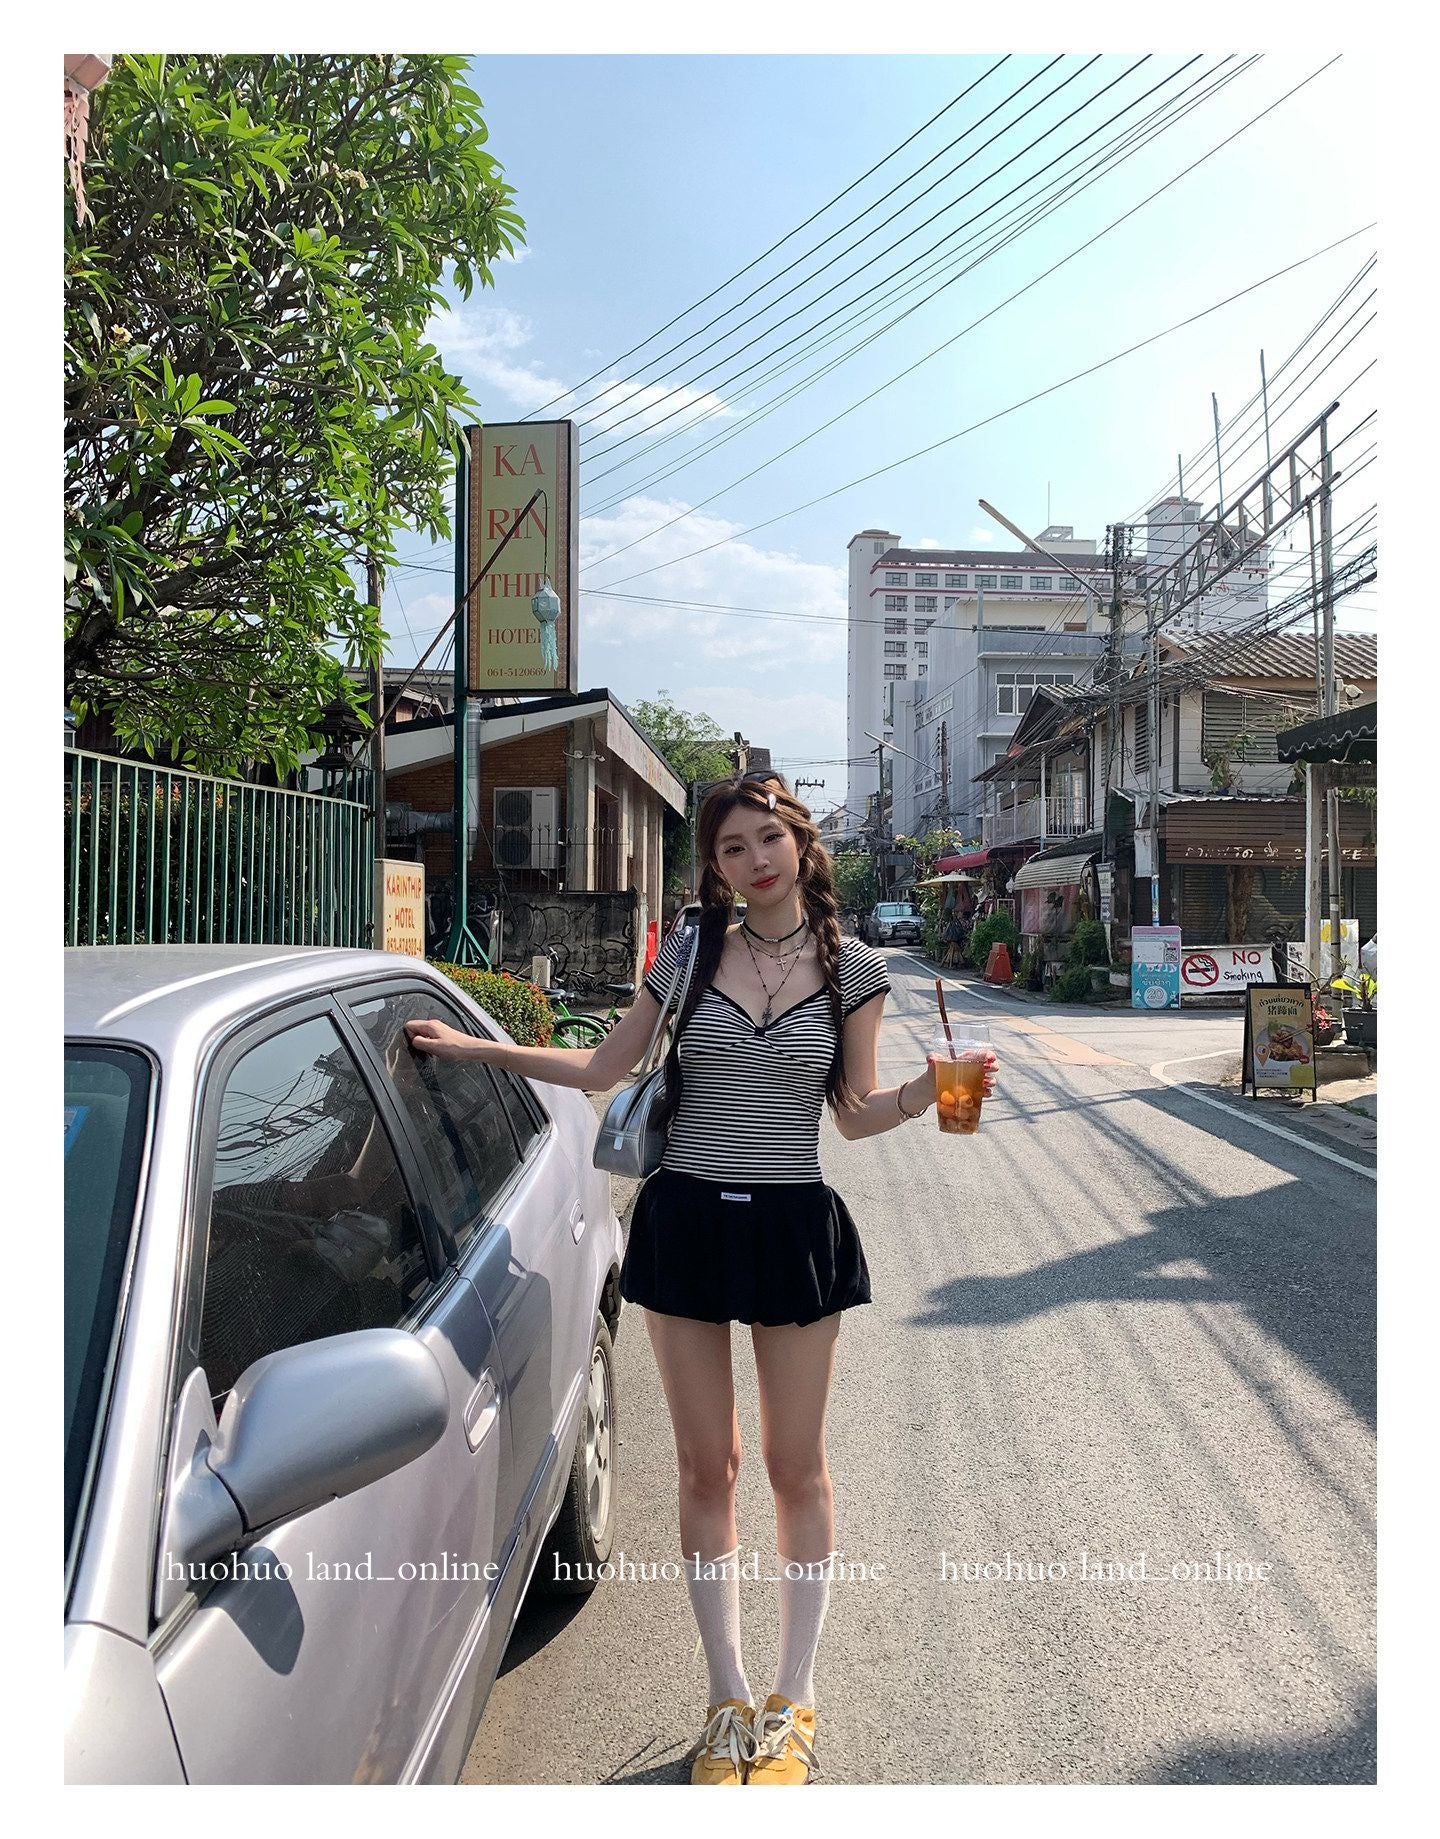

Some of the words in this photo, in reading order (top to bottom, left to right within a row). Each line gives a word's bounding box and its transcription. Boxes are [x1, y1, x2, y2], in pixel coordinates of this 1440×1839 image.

[492, 443, 545, 477] KA
[486, 506, 550, 540] RIN
[394, 907, 415, 929] HOTEL
[1232, 950, 1261, 965] NO
[1146, 988, 1165, 1001] 20
